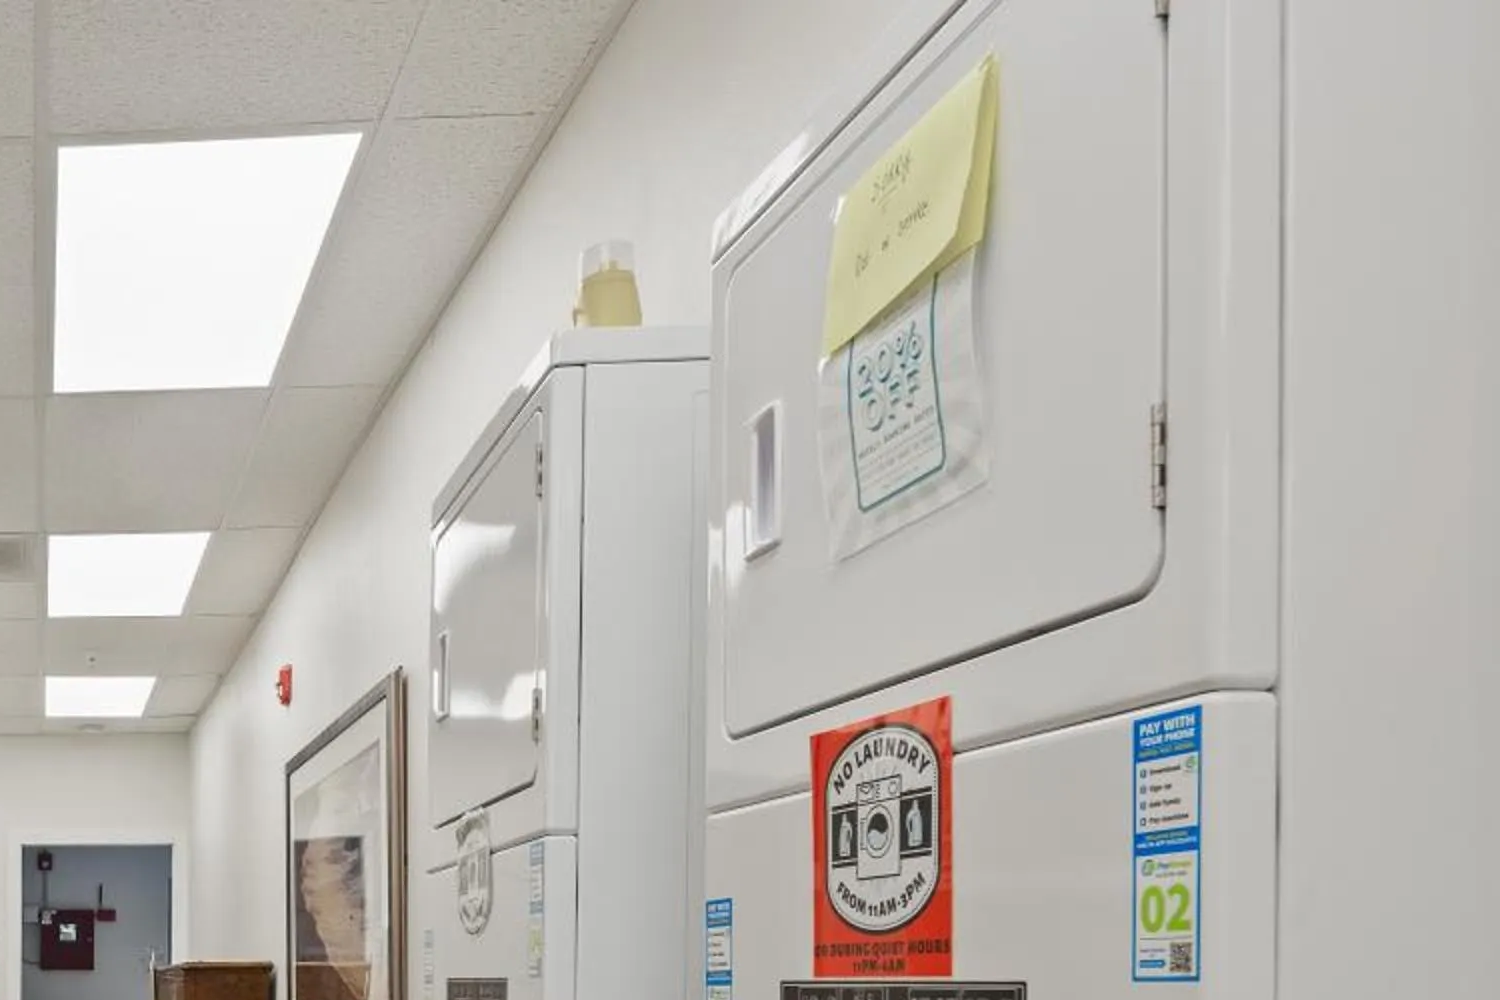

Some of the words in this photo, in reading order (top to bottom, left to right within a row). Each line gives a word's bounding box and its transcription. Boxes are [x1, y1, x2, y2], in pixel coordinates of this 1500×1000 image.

[857, 321, 923, 398] 20%
[861, 366, 922, 432] OFF
[1139, 721, 1161, 737] PAY
[1163, 713, 1195, 731] WITH
[833, 761, 854, 795] NO
[854, 737, 931, 775] LAUNDRY
[836, 881, 867, 915] FROM
[1141, 883, 1191, 933] 02
[871, 941, 905, 957] QUIET
[907, 938, 950, 955] HOURS
